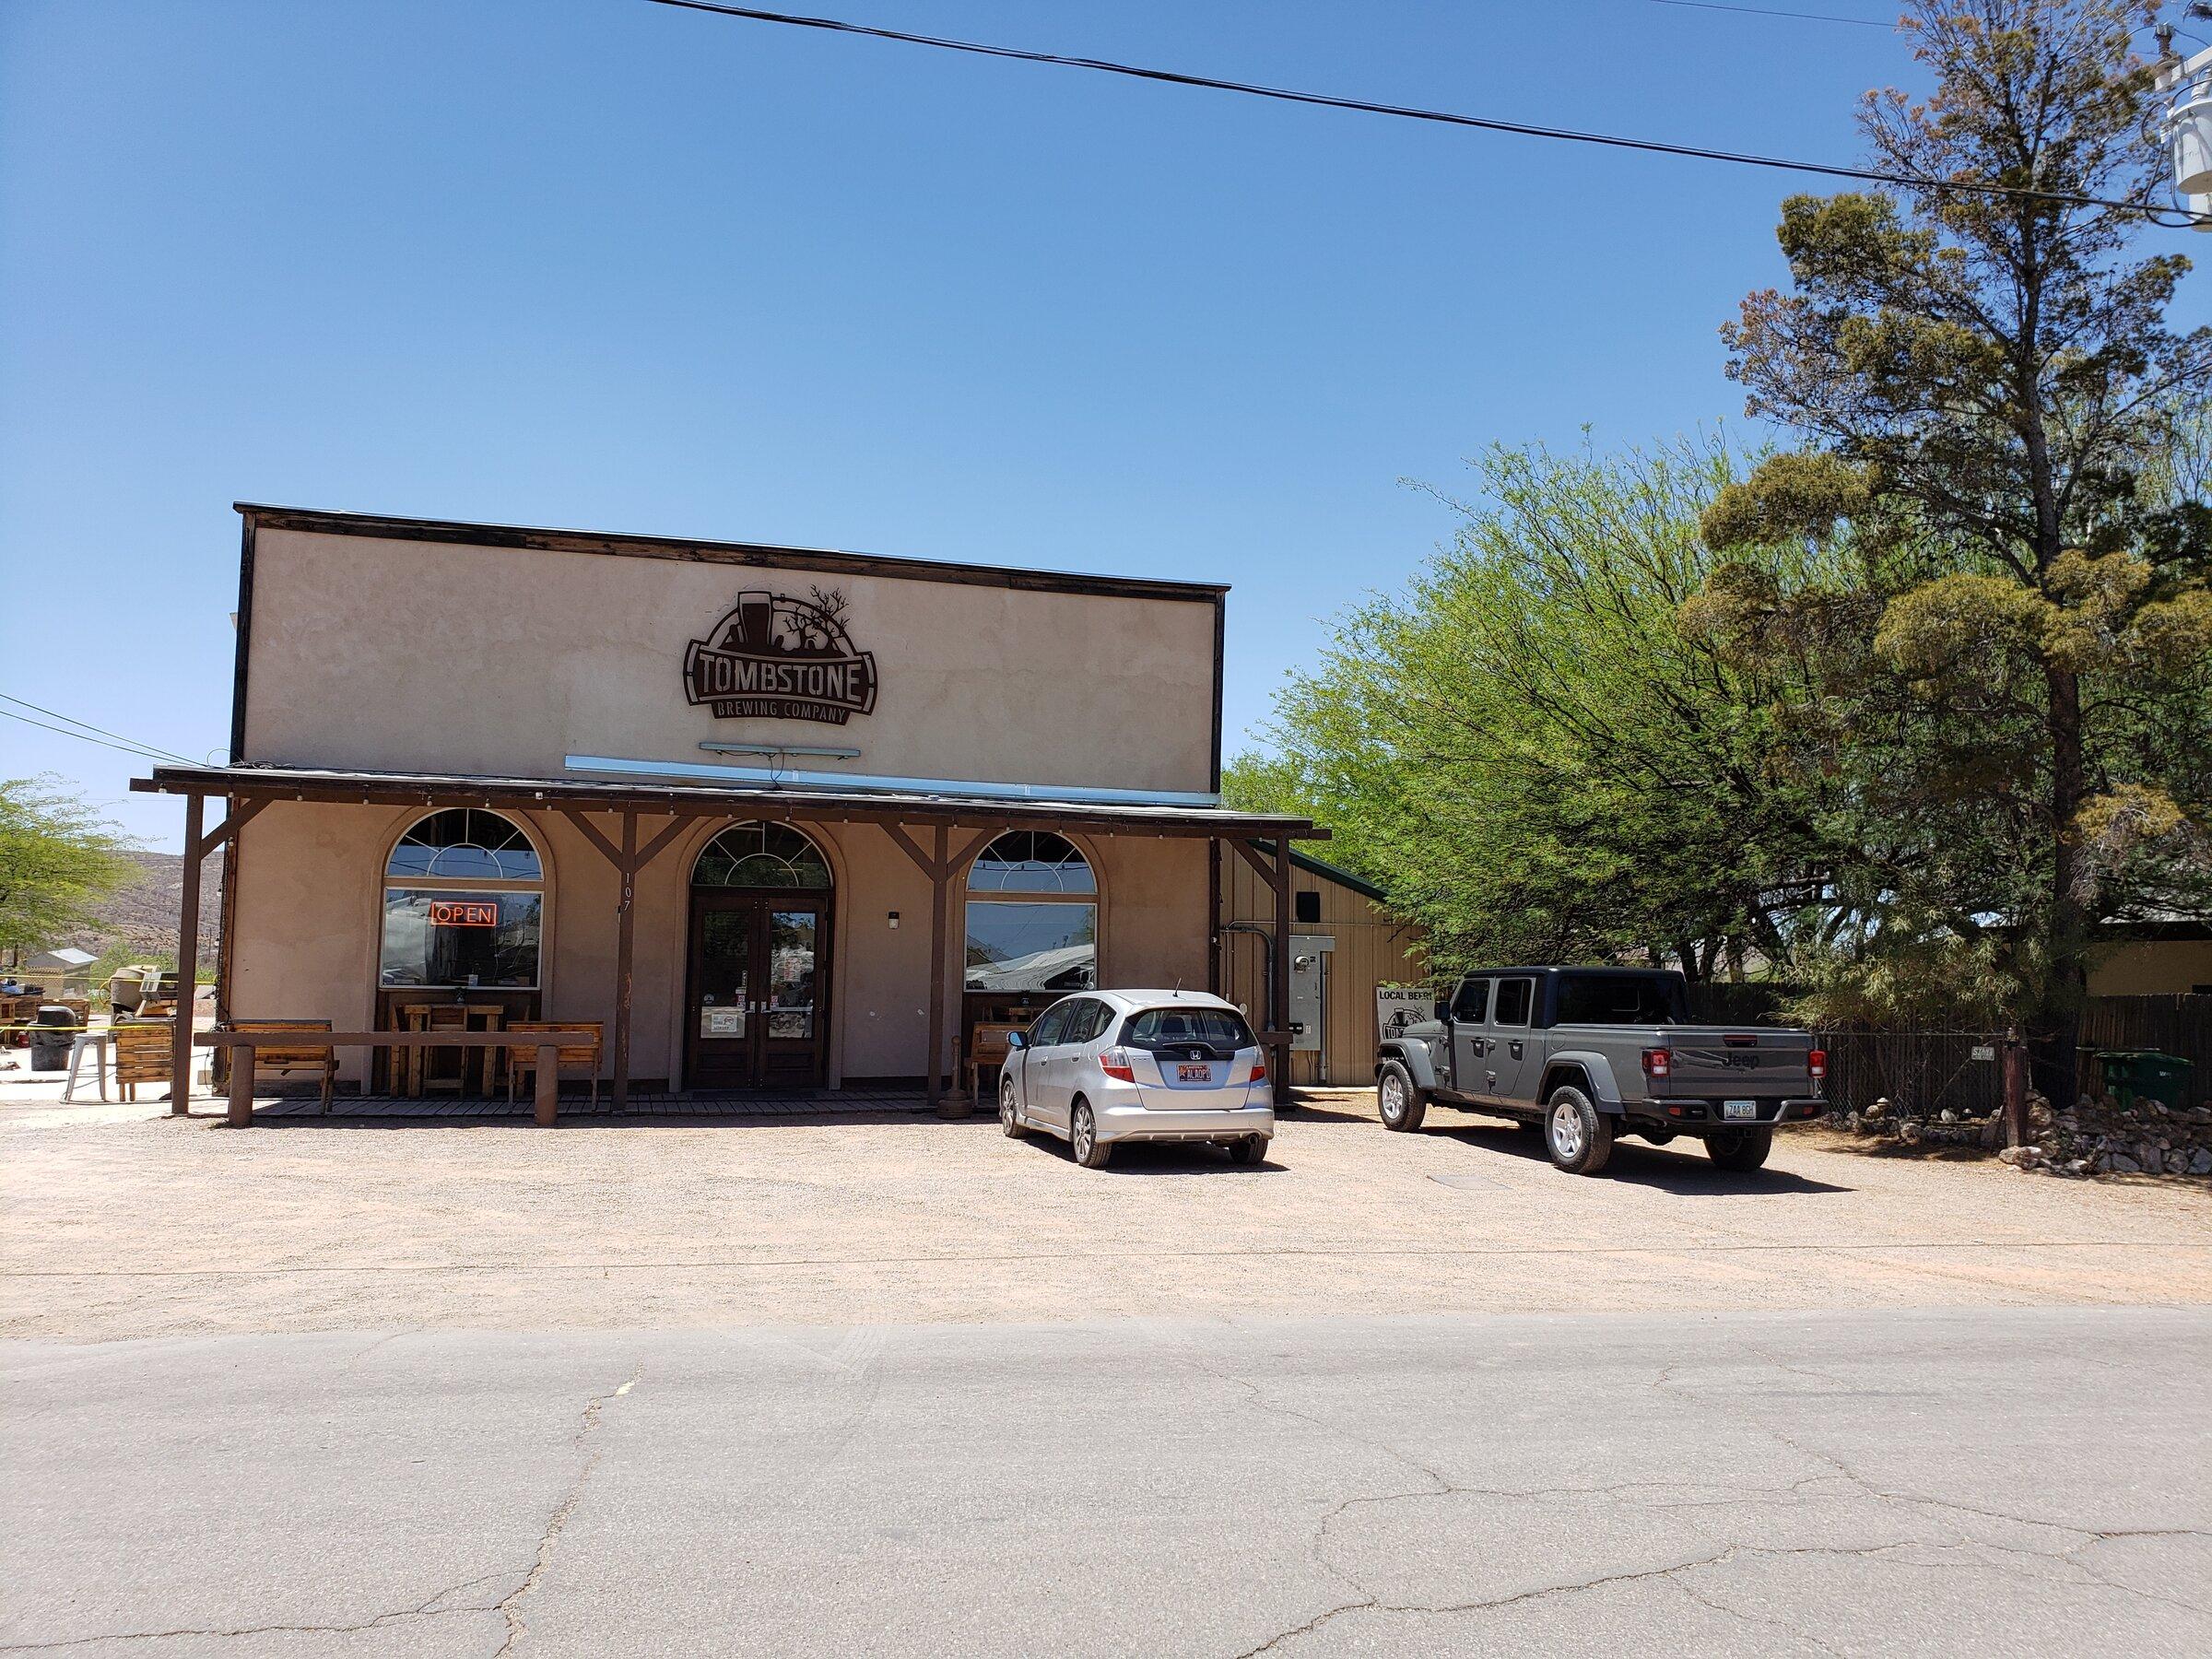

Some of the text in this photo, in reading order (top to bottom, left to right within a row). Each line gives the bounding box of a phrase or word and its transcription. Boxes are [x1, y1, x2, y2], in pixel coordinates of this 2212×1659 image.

[699, 653, 862, 703] TOMBSTONE
[717, 700, 846, 724] BREWING COMPANY
[437, 907, 491, 923] OPEN
[1379, 991, 1406, 1000] LOCAL
